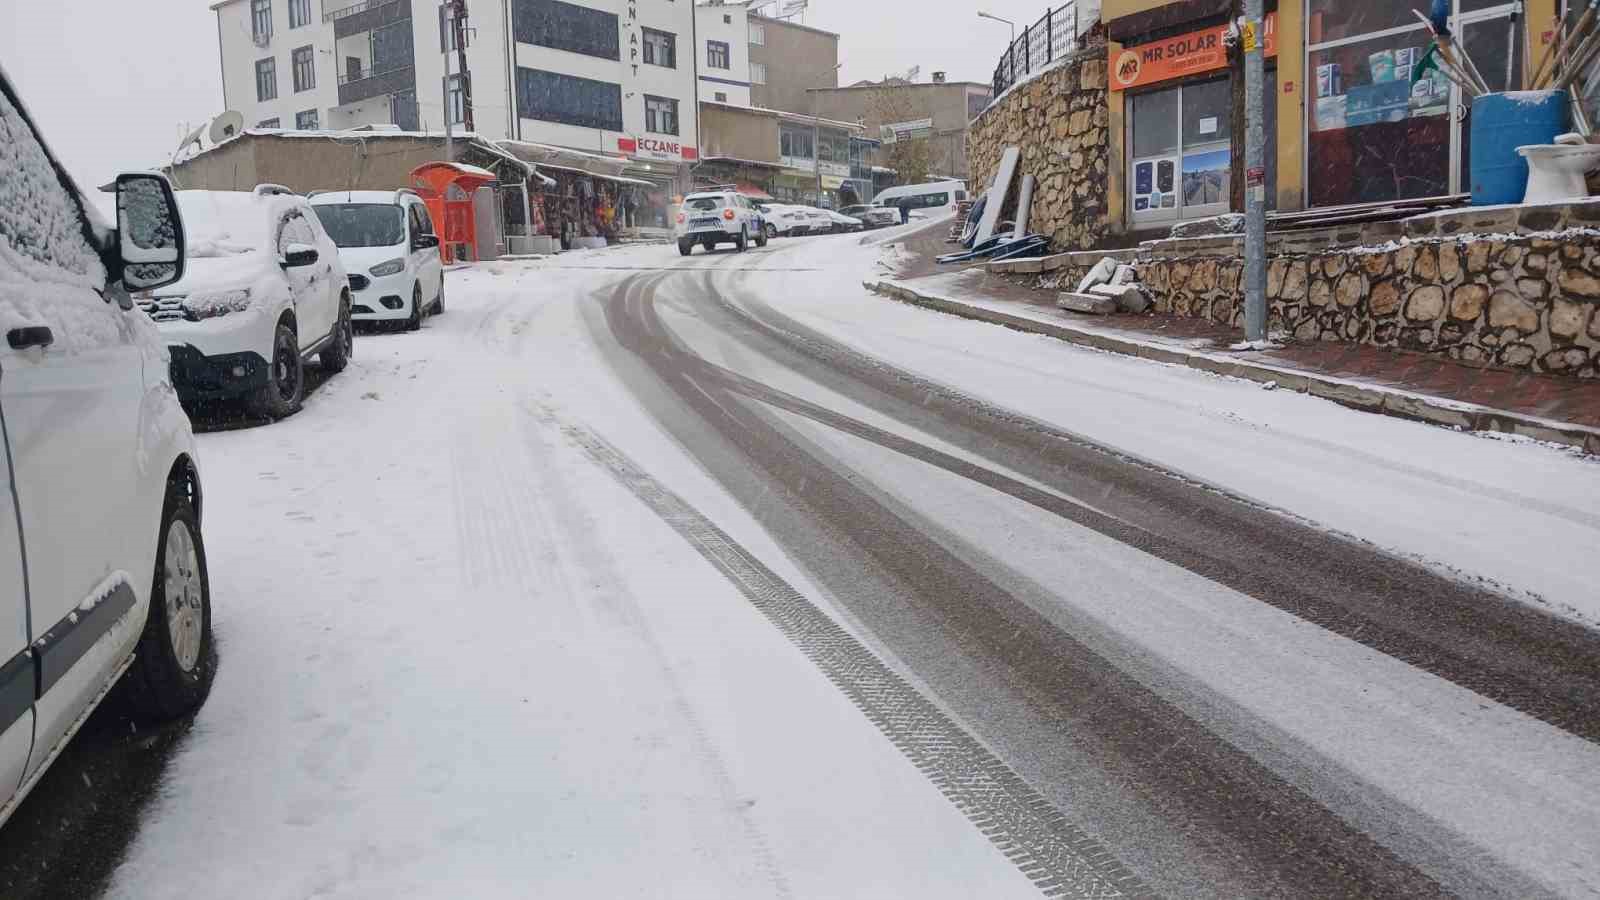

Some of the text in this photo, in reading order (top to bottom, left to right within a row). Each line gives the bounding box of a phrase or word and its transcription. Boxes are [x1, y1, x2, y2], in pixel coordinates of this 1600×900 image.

[630, 32, 639, 77] APT
[1142, 48, 1163, 64] MR
[1167, 34, 1217, 58] SOLAR
[638, 137, 680, 155] ECZANE
